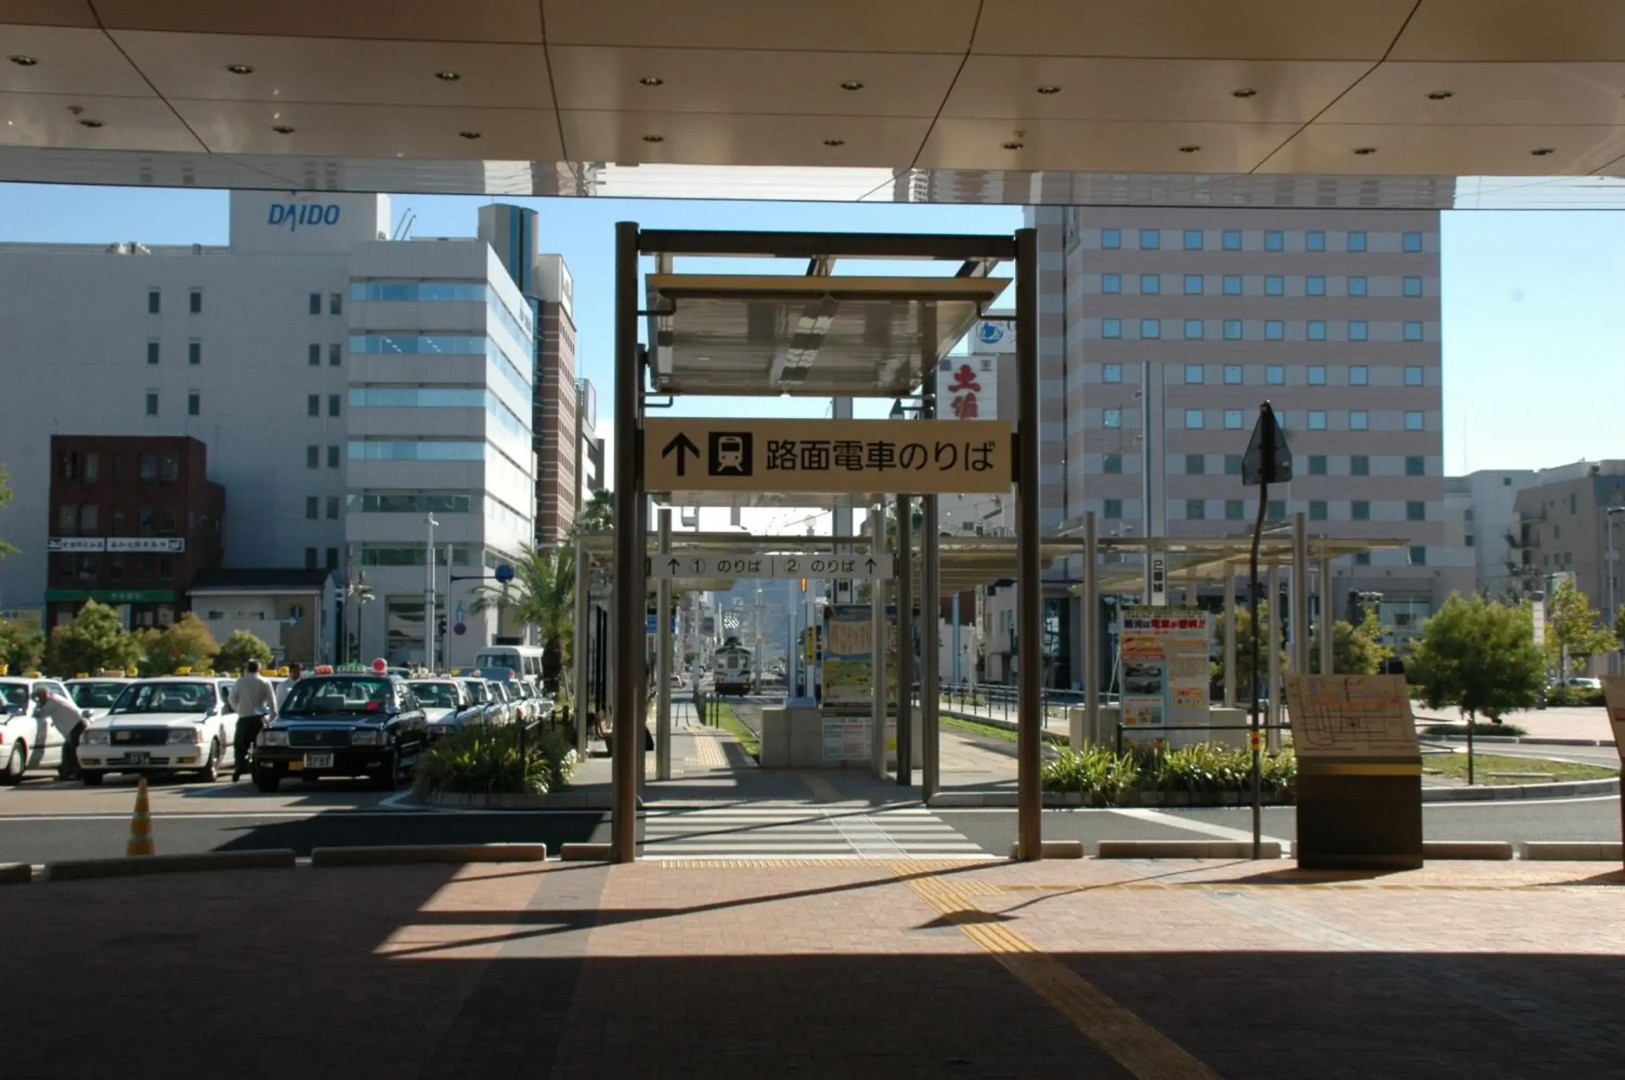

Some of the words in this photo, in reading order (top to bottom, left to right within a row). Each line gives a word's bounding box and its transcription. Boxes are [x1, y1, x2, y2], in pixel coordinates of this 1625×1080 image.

[268, 204, 340, 233] DAIDO
[766, 439, 996, 472] 路面電車のりば
[717, 559, 762, 573] のりば
[811, 559, 855, 573] のりば
